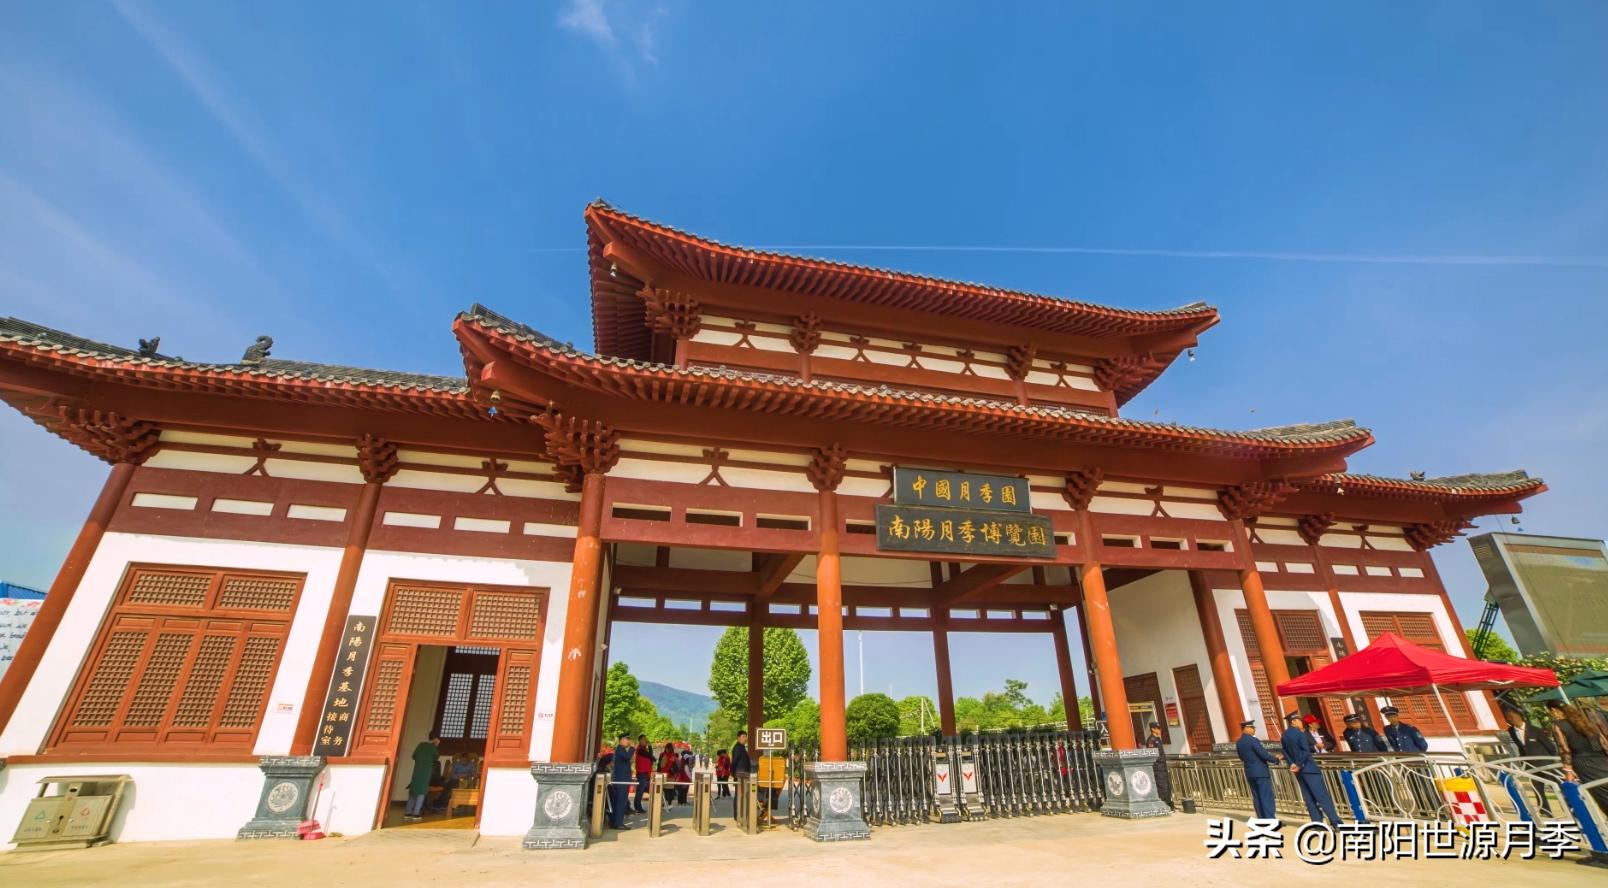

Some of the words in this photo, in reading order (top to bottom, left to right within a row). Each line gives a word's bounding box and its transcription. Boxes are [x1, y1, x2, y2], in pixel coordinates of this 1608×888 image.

[912, 474, 1017, 506] 中國月季園
[888, 515, 1047, 547] 南陽月季博覽園
[333, 621, 366, 708] 南陽月季基地
[761, 730, 783, 744] 出口
